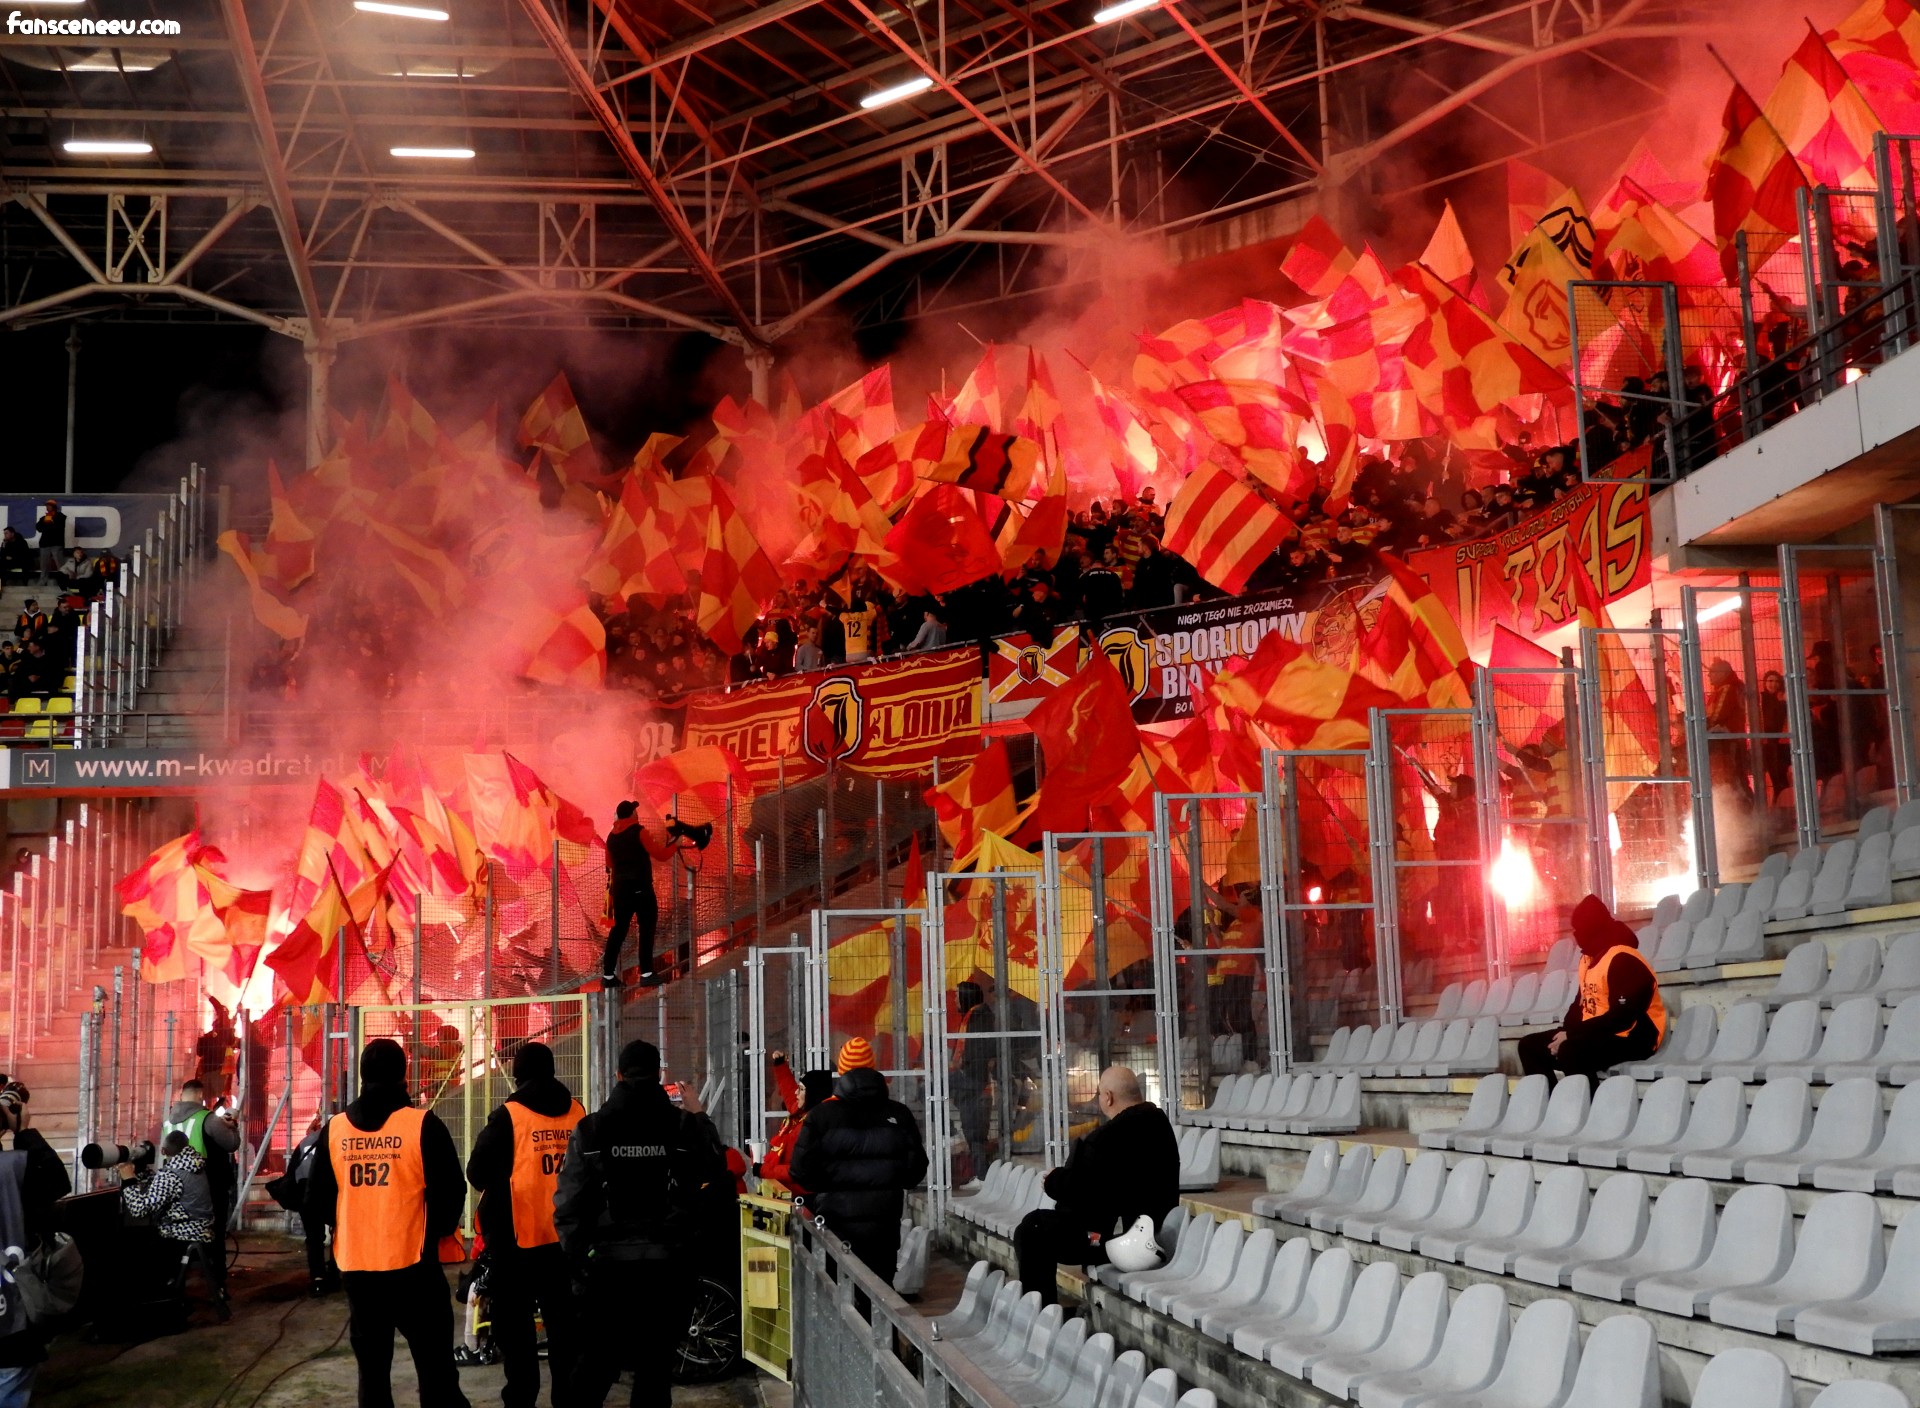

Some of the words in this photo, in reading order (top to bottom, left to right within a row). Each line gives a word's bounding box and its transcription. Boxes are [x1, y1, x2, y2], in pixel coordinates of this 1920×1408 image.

[1177, 612, 1203, 626] NIGDY
[1204, 609, 1225, 623] TEGO
[1227, 606, 1241, 618] NIE
[847, 620, 861, 638] 12
[1155, 611, 1306, 667] SPORTOWY
[341, 1136, 402, 1151] STEWARD
[532, 1129, 573, 1142] STEWAR
[611, 1145, 666, 1157] OCHRONA
[541, 1153, 566, 1175] 02
[349, 1162, 390, 1187] 052
